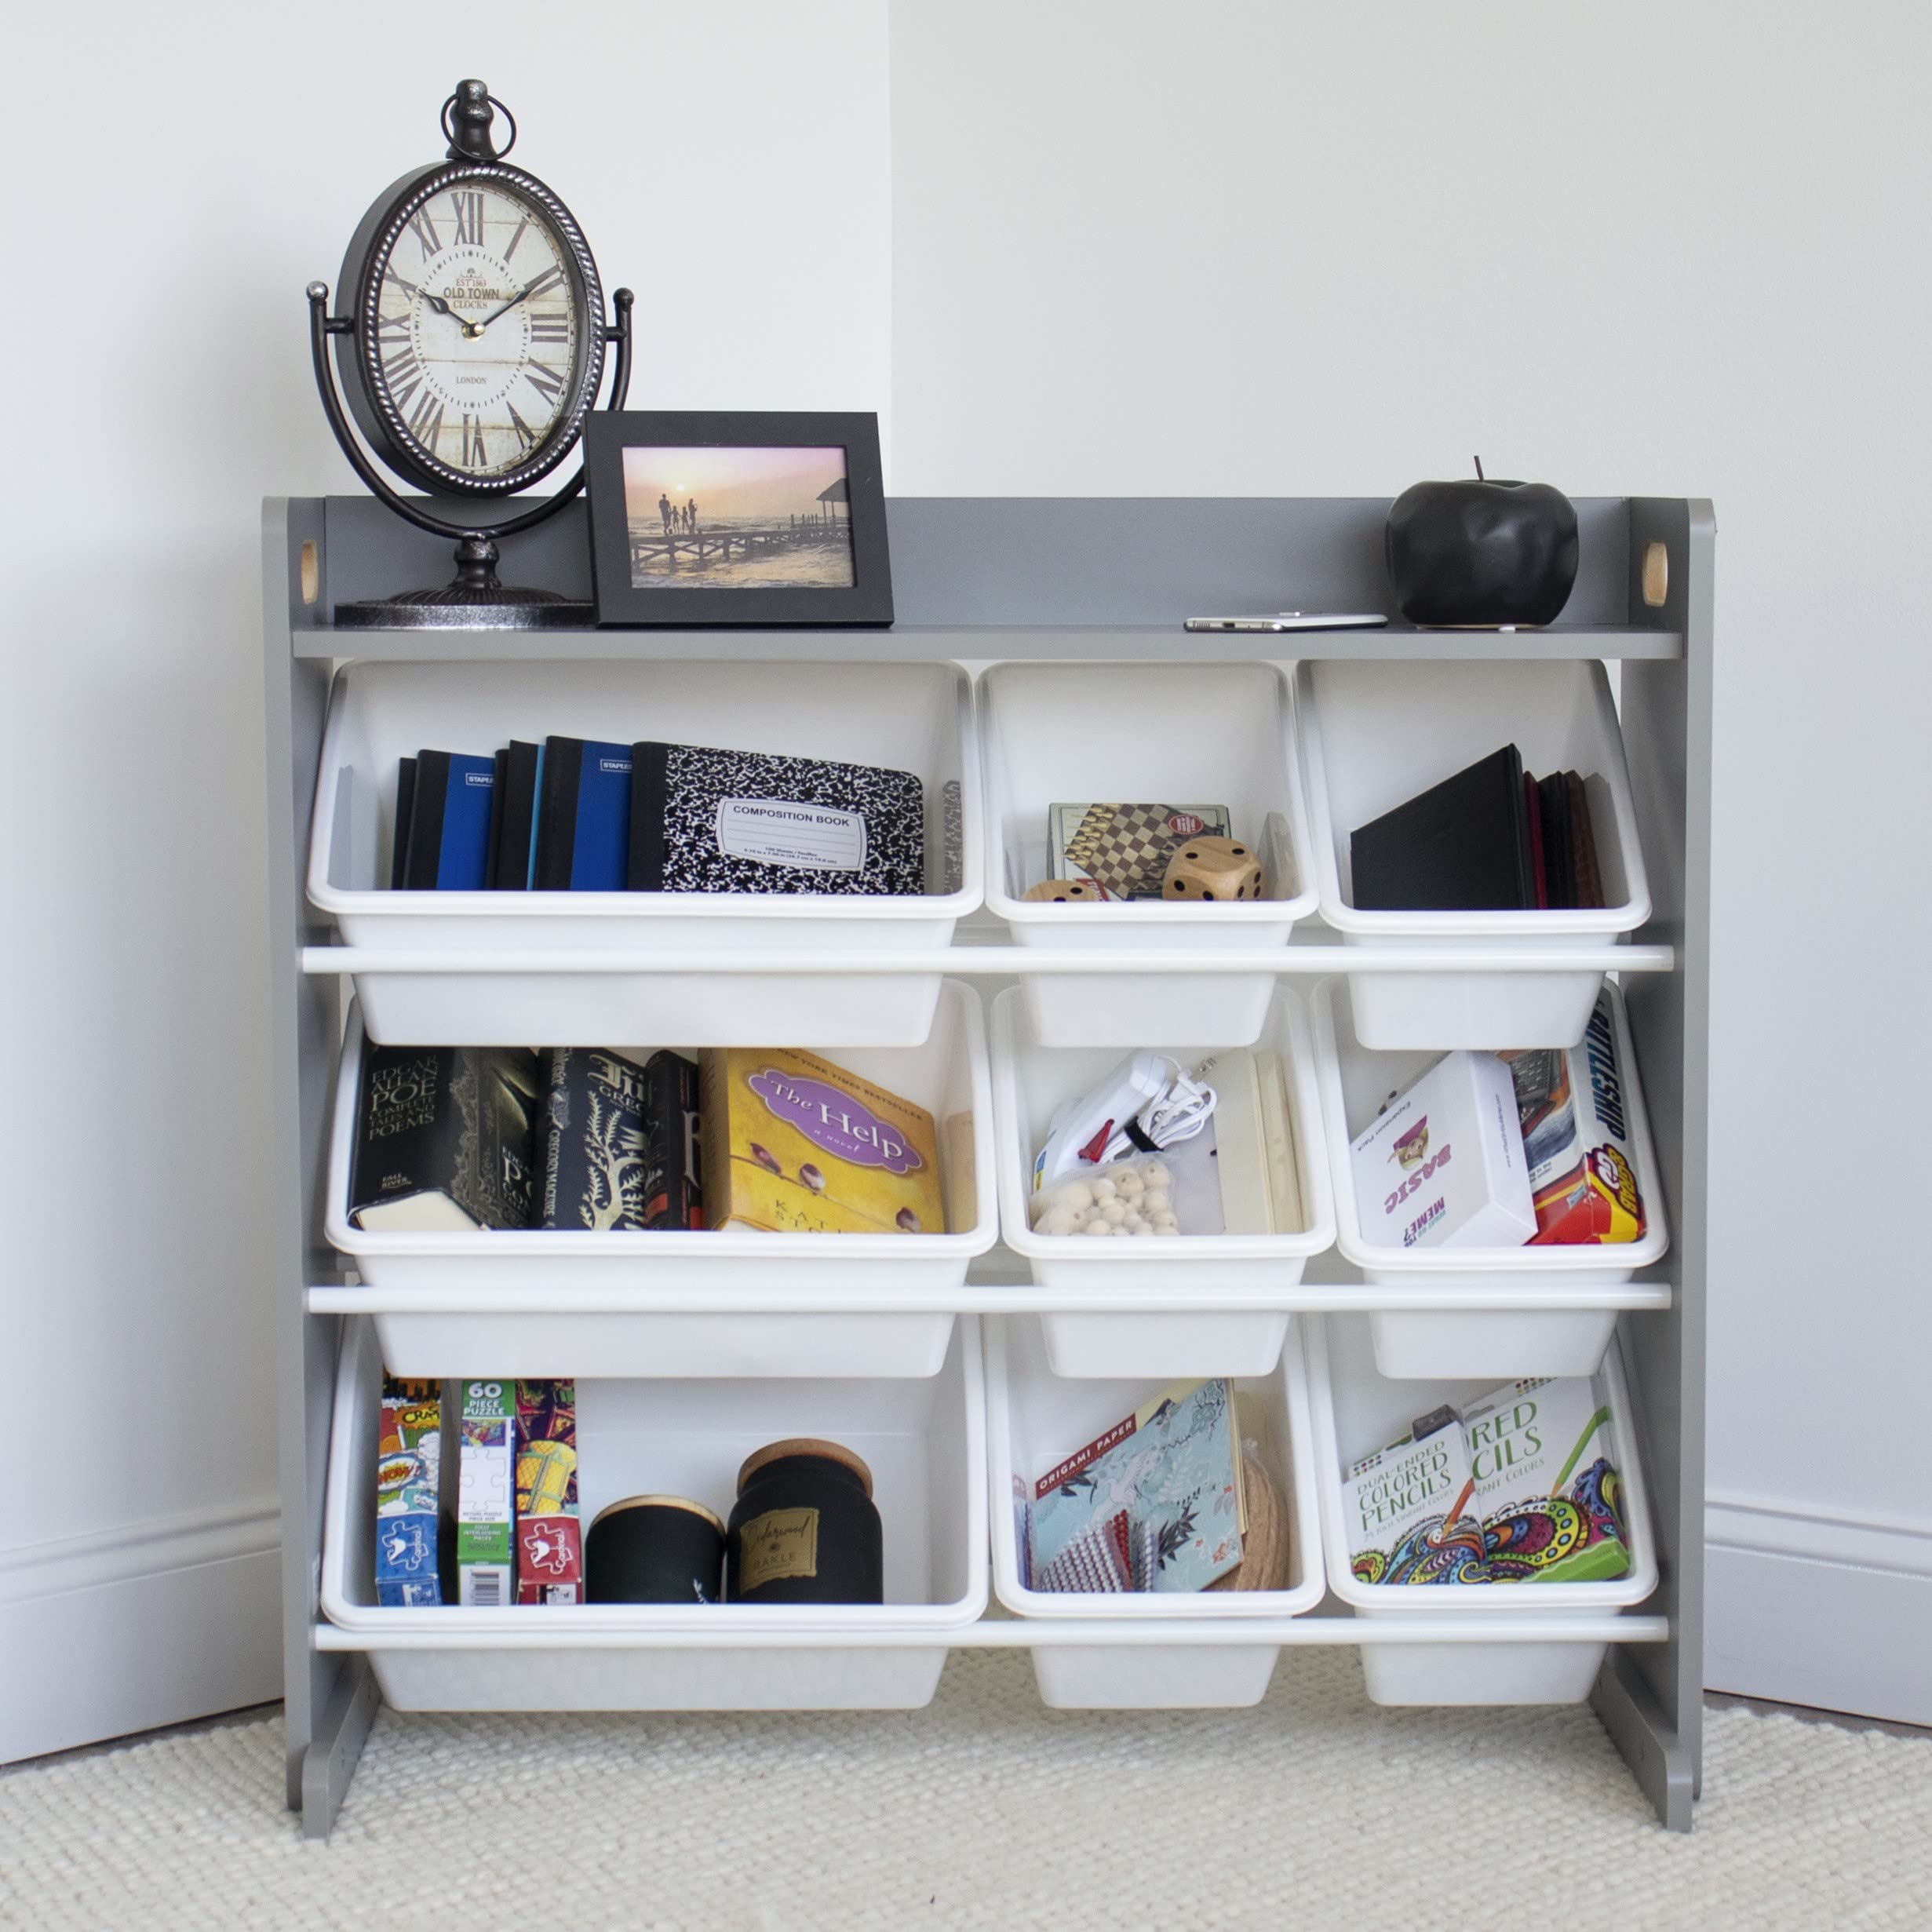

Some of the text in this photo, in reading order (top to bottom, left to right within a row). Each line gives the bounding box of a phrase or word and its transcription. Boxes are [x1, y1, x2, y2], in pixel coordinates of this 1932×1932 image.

[443, 287, 499, 299] OLD TOWN
[453, 300, 488, 309] CLOCKS
[456, 376, 487, 385] LONDON
[733, 805, 850, 827] COMPOSITION BOOK
[371, 1066, 437, 1095] ALLAN
[372, 1055, 438, 1083] EDGAR
[372, 1076, 436, 1112] POE
[801, 1058, 827, 1075] YORK
[832, 1073, 861, 1090] TIMES
[864, 1089, 922, 1121] BESTSELLER
[369, 1114, 434, 1141] POEMS
[770, 1080, 902, 1160] The Help
[1358, 1101, 1411, 1151] Expansion Pack
[547, 1130, 560, 1175] GREGORY
[826, 1135, 861, 1152] novel
[543, 1175, 557, 1218] MAGUIRE
[1384, 1144, 1452, 1214] BASIC
[1403, 1196, 1445, 1242] MEME?
[468, 1382, 502, 1399] 60
[464, 1407, 505, 1416] PUZZLE
[1039, 1449, 1090, 1489] ORIGAMI
[1097, 1420, 1132, 1451] PAPER
[1357, 1441, 1445, 1496] DUAL-ENDED
[1505, 1458, 1545, 1483] COLORS
[1360, 1452, 1448, 1511] COLORED
[1362, 1469, 1451, 1532] PENCILS
